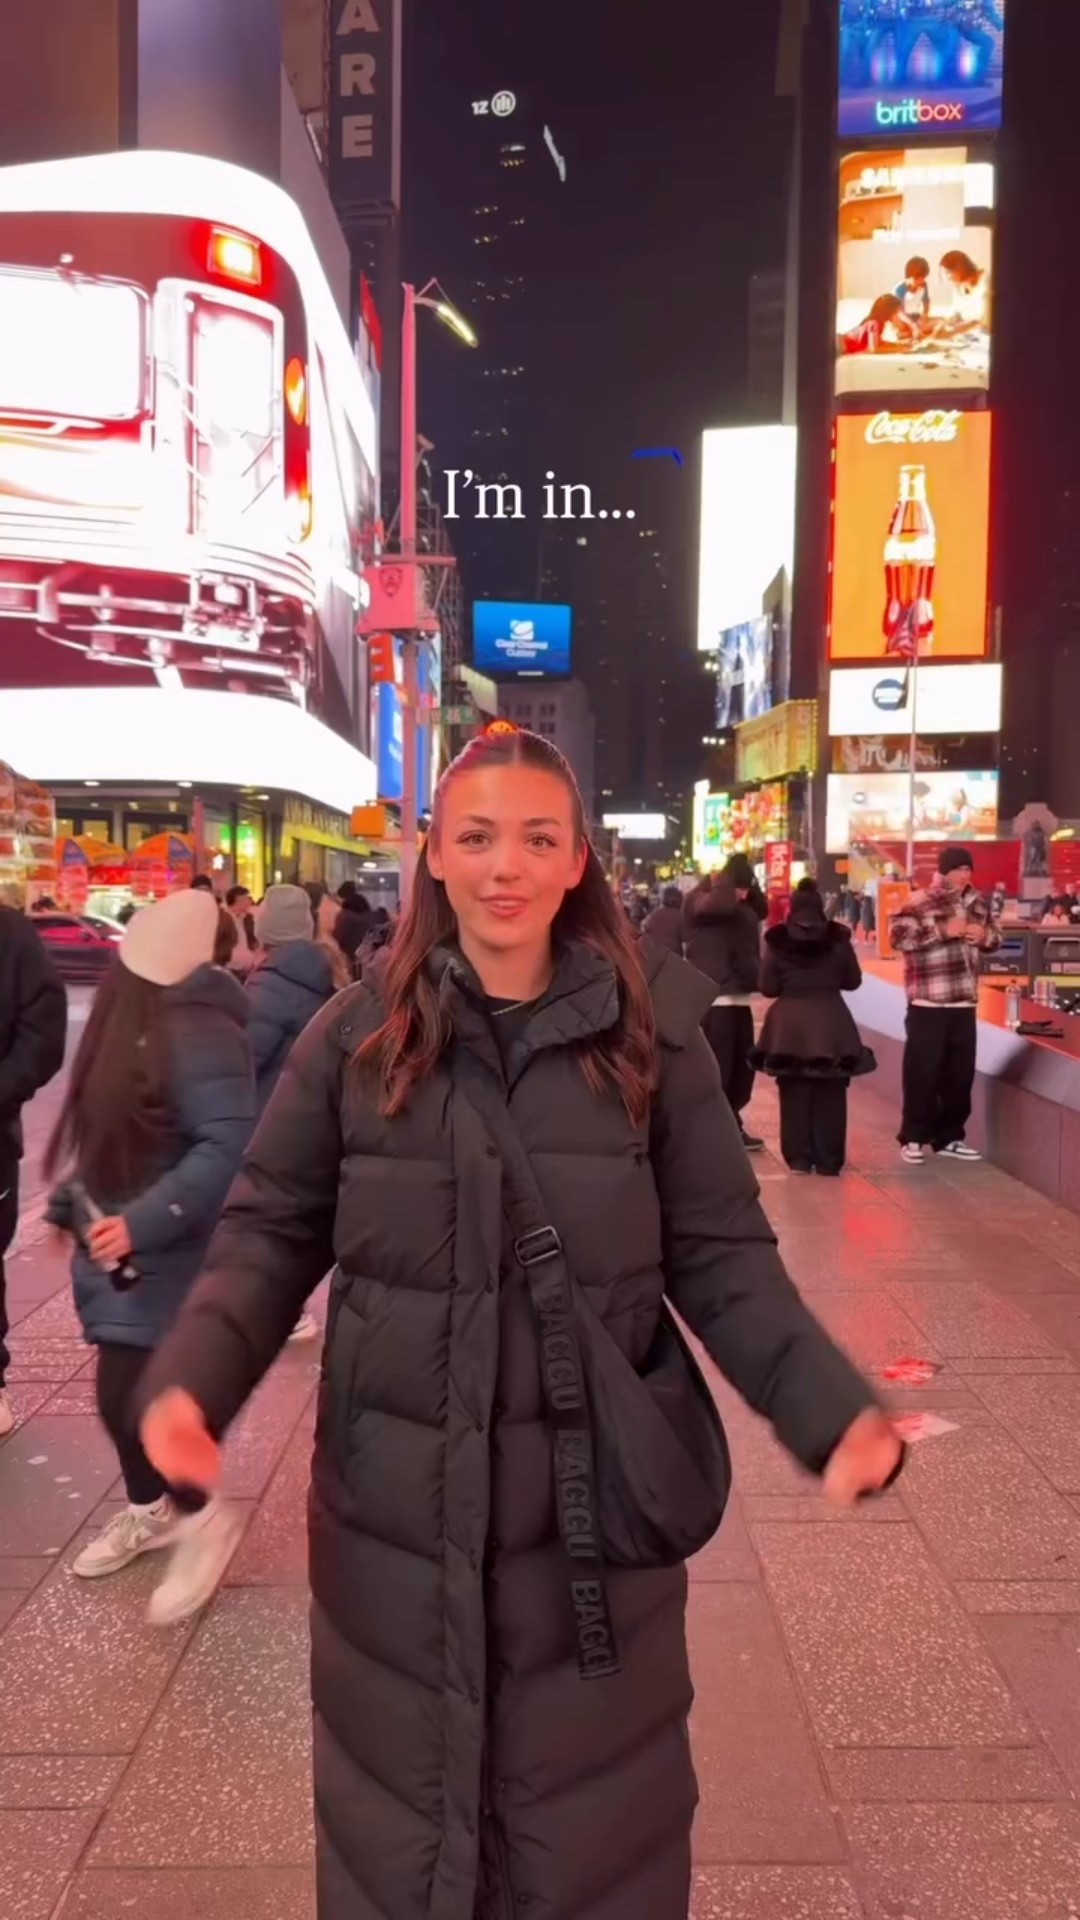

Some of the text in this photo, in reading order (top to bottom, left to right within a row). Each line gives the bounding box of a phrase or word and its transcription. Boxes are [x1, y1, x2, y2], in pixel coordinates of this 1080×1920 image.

[876, 98, 962, 124] britbox
[865, 409, 964, 444] Coca-Cola
[556, 1429, 597, 1557] BAGGU
